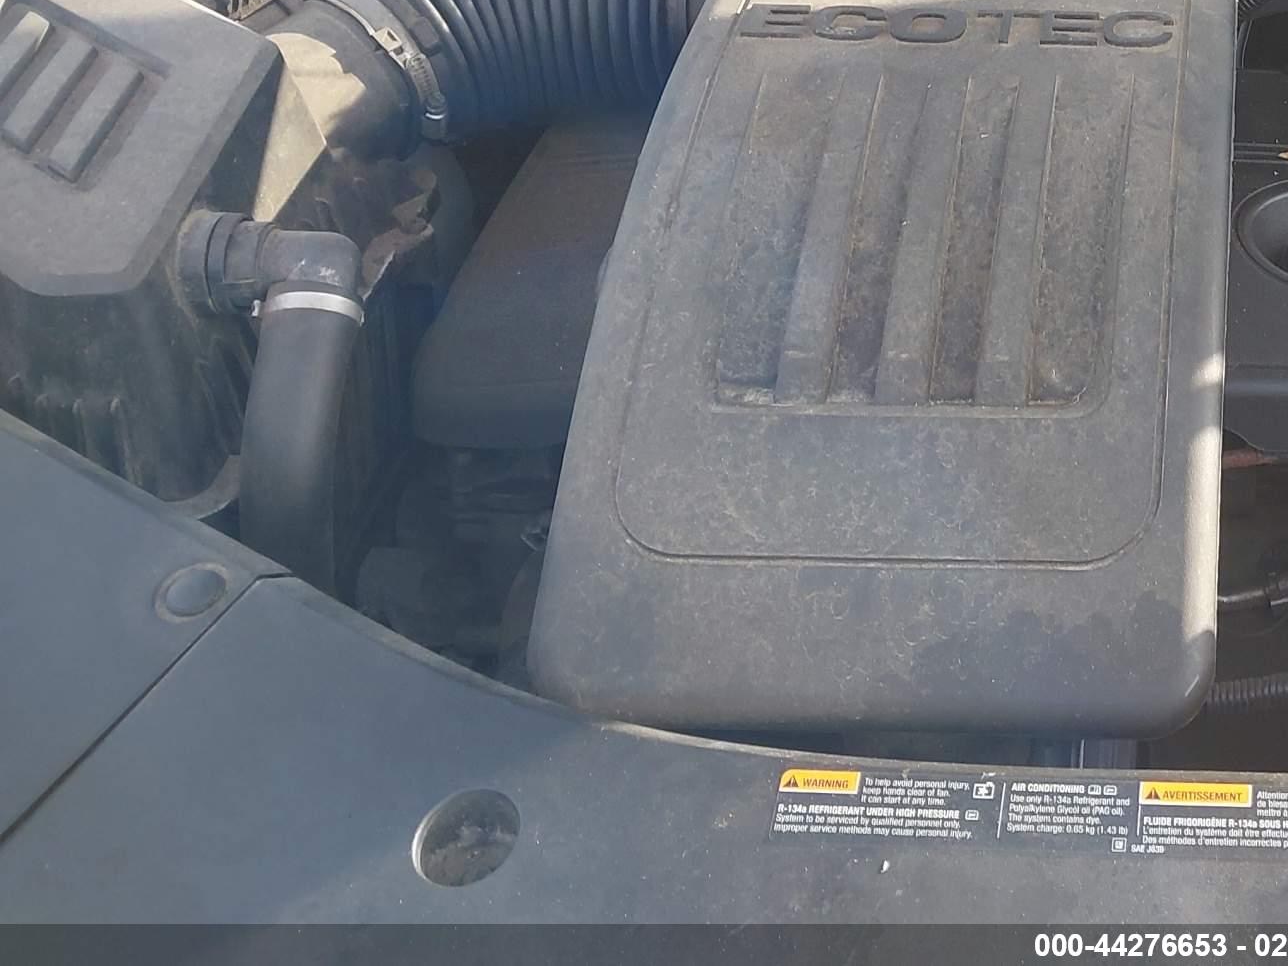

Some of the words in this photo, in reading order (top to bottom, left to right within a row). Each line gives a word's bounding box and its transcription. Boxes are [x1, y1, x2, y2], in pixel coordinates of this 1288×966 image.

[740, 4, 1174, 48] ECOTEC
[803, 778, 848, 788] WARNING
[865, 777, 872, 786] To
[874, 778, 890, 788] help
[892, 778, 912, 787] avoid
[914, 780, 946, 789] personal
[1011, 783, 1026, 792] AIR
[1028, 784, 1084, 794] CONDITIONING
[863, 786, 881, 796] keep
[883, 787, 905, 796] hands
[907, 788, 925, 796] clear
[927, 788, 935, 796] of
[937, 789, 950, 797] fan.
[1162, 791, 1242, 802] AVERTISSEMENT
[861, 795, 866, 803] It
[884, 796, 900, 804] start
[1010, 794, 1024, 802] Use
[1026, 794, 1040, 804] only
[1044, 795, 1071, 804] R-134a
[1074, 796, 1114, 806] Refrigerant
[1116, 797, 1130, 806] and
[778, 804, 806, 814] R-134a
[809, 804, 865, 815] REFRIGERANT
[866, 806, 894, 816] UNDER
[896, 808, 916, 817] HIGH
[918, 808, 960, 819] PRESSURE
[1009, 803, 1055, 814] Polyalkylene
[1057, 805, 1080, 814] Glycol
[1092, 806, 1110, 815] (PAG
[1112, 807, 1124, 816] oil).
[776, 813, 804, 823] System
[806, 814, 813, 822] to
[815, 814, 824, 823] be
[827, 816, 858, 824] serviced
[861, 816, 870, 826] by
[871, 817, 904, 826] qualified
[905, 818, 942, 827] personnel
[944, 820, 960, 828] only.
[1008, 813, 1022, 822] The
[1024, 814, 1050, 824] system
[1052, 816, 1084, 824] contains
[1086, 816, 1101, 825] dye.
[1144, 816, 1172, 826] FLUIDE
[1228, 818, 1258, 828] R-134a
[1259, 820, 1281, 828] SOUS
[774, 823, 808, 833] Improper
[810, 825, 836, 833] service
[838, 826, 871, 834] methods
[874, 828, 890, 836] may
[892, 828, 914, 836] cause
[916, 828, 948, 837] personal
[950, 830, 972, 839] injury.
[1007, 823, 1034, 832] System
[1036, 824, 1064, 834] charge:
[1066, 825, 1084, 834] 0.65
[1086, 826, 1095, 835] kg
[1097, 826, 1116, 835] (1.43
[1118, 826, 1128, 836] lb)
[1143, 826, 1182, 835] L'entretien
[1184, 828, 1194, 836] du
[1142, 835, 1157, 844] Des
[1198, 837, 1238, 846] d'entretien
[1240, 838, 1282, 846] incorrectes
